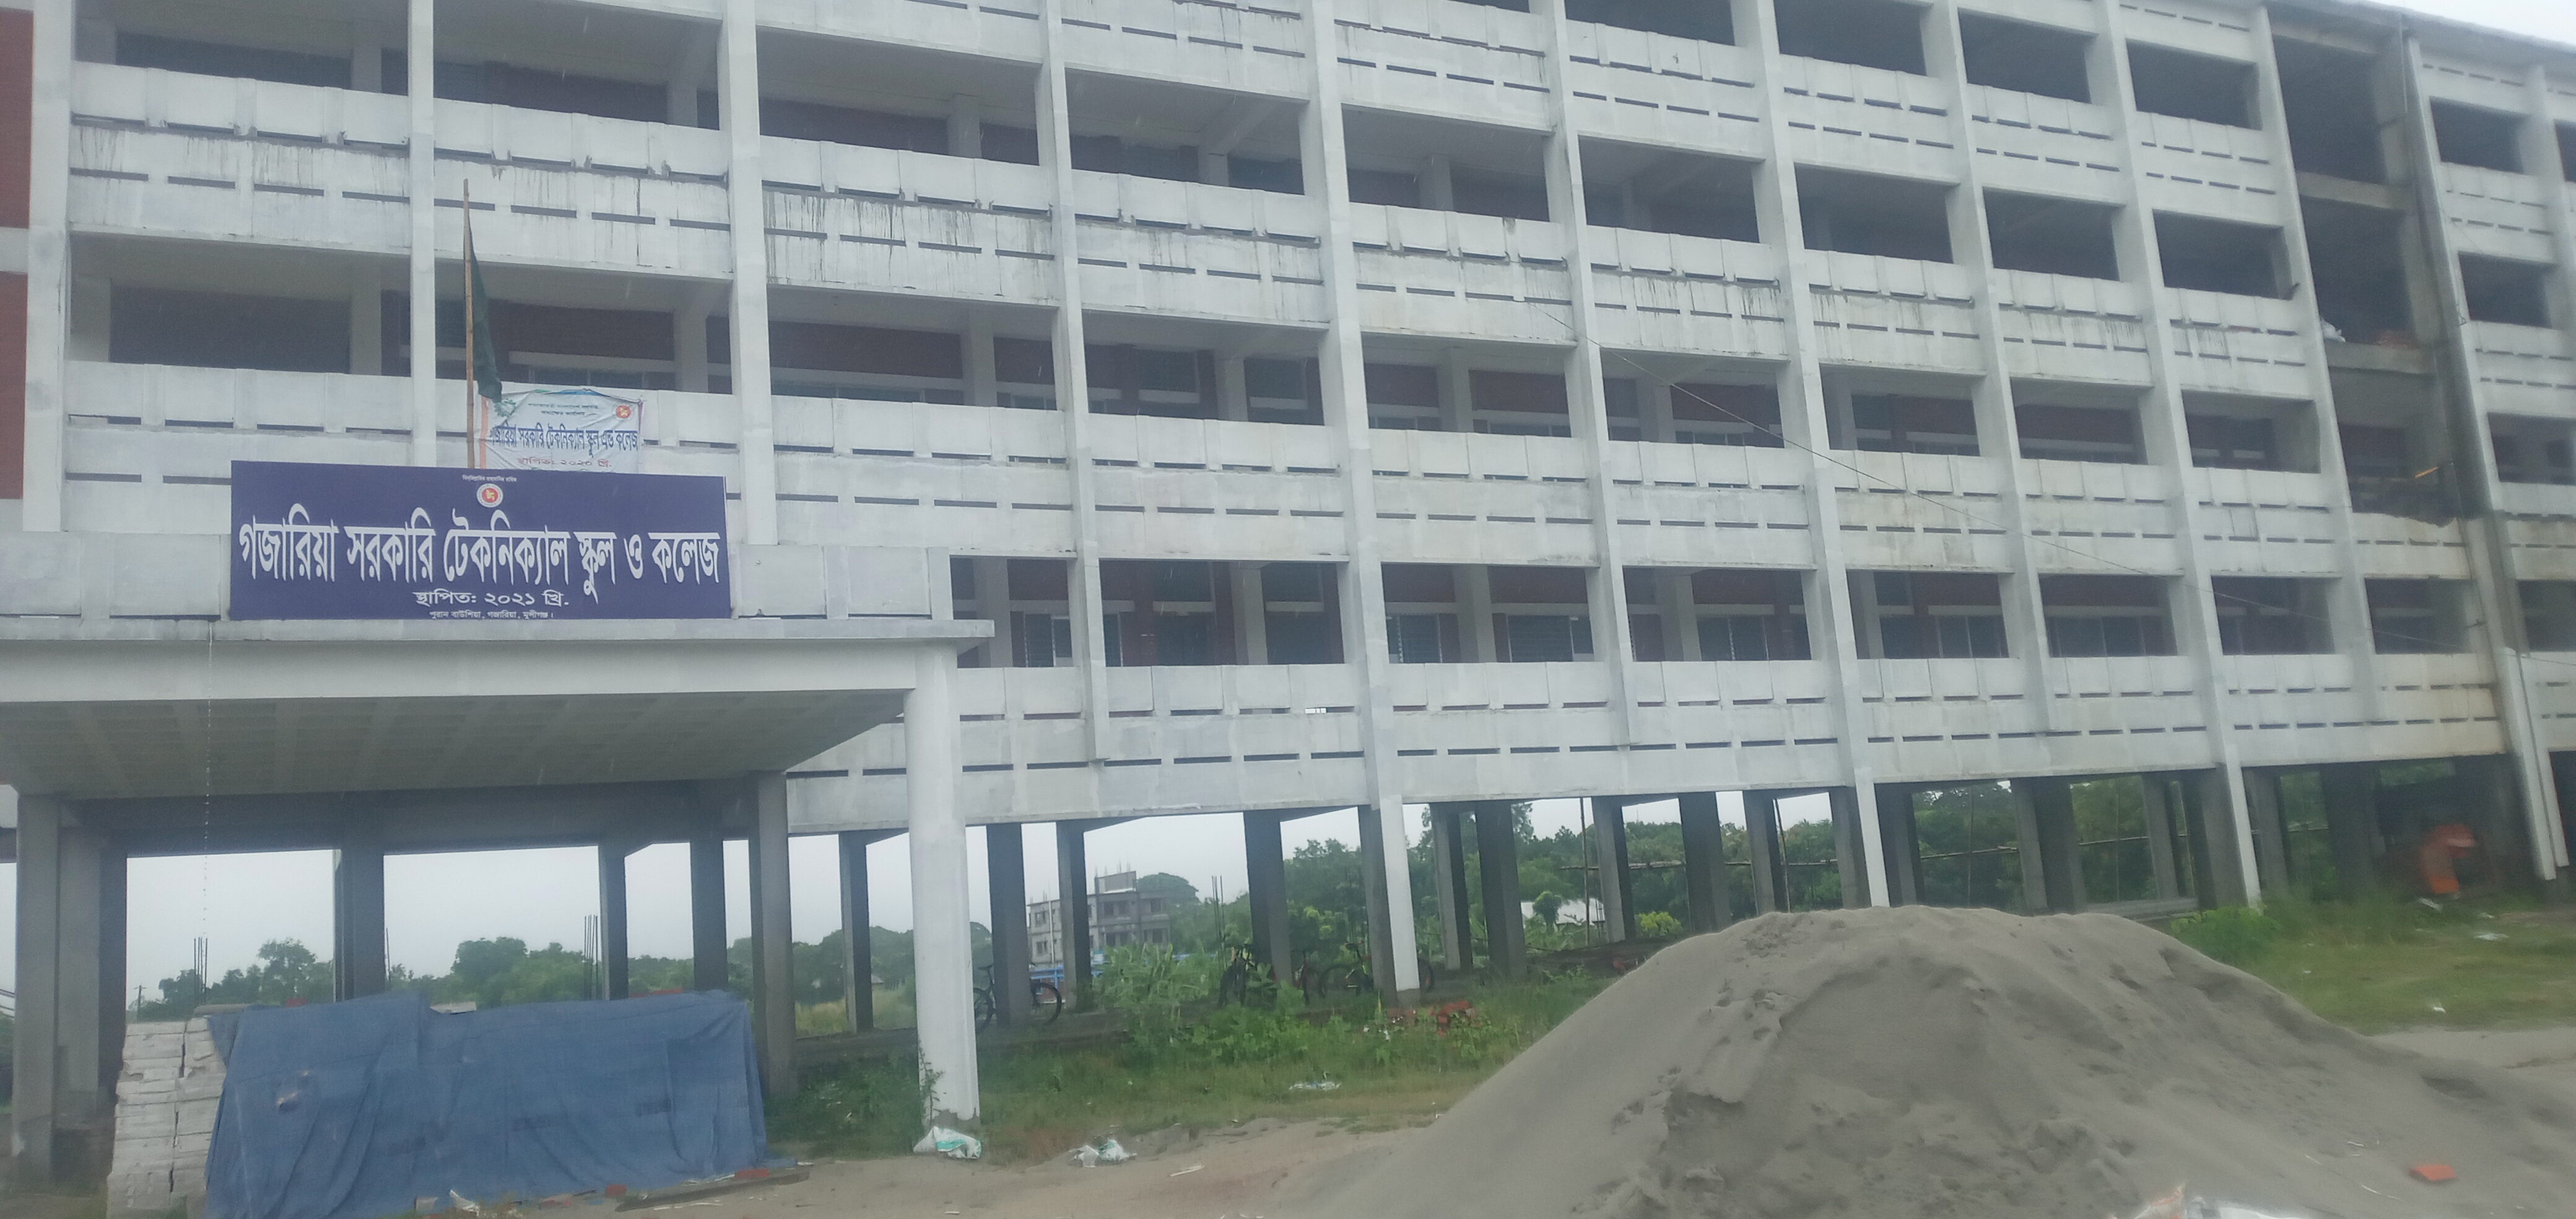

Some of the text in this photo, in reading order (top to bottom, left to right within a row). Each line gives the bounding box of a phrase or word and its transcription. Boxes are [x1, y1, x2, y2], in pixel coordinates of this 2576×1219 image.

[518, 422, 544, 448] সরকারি
[546, 423, 584, 450] টেকনিক্যাল
[586, 430, 599, 458] স্কুল
[614, 430, 638, 451] কলেজ
[239, 503, 721, 605] গজারিয়া সরকারি টেকনিক্যাল স্কুল ও কলেজ
[484, 592, 536, 606] ২০২১
